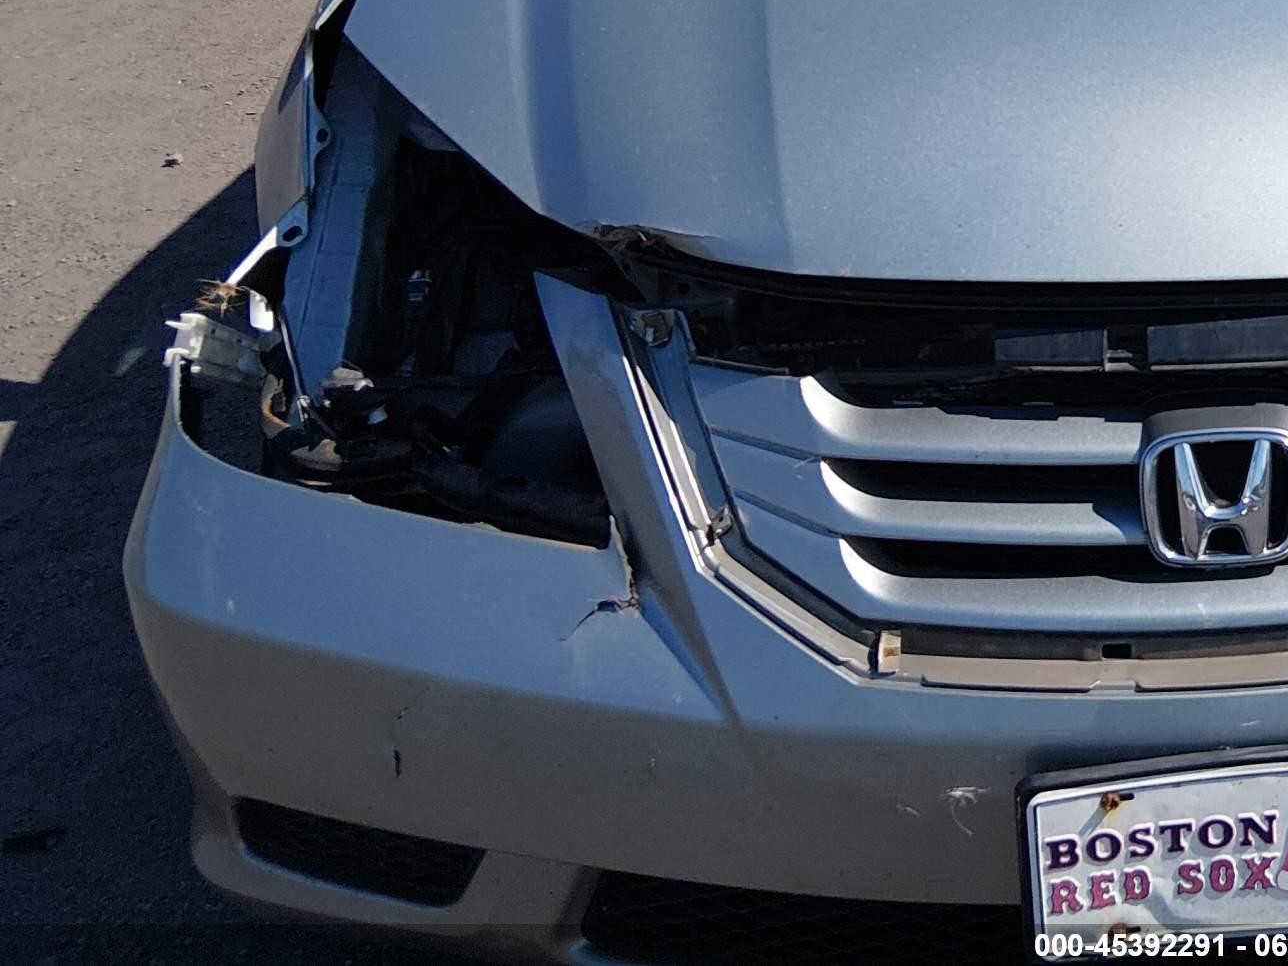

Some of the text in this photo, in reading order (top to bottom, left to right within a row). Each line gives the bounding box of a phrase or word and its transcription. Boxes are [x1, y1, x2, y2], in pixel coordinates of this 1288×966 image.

[1044, 812, 1279, 870] BOSTON
[1048, 854, 1279, 916] RED SOX
